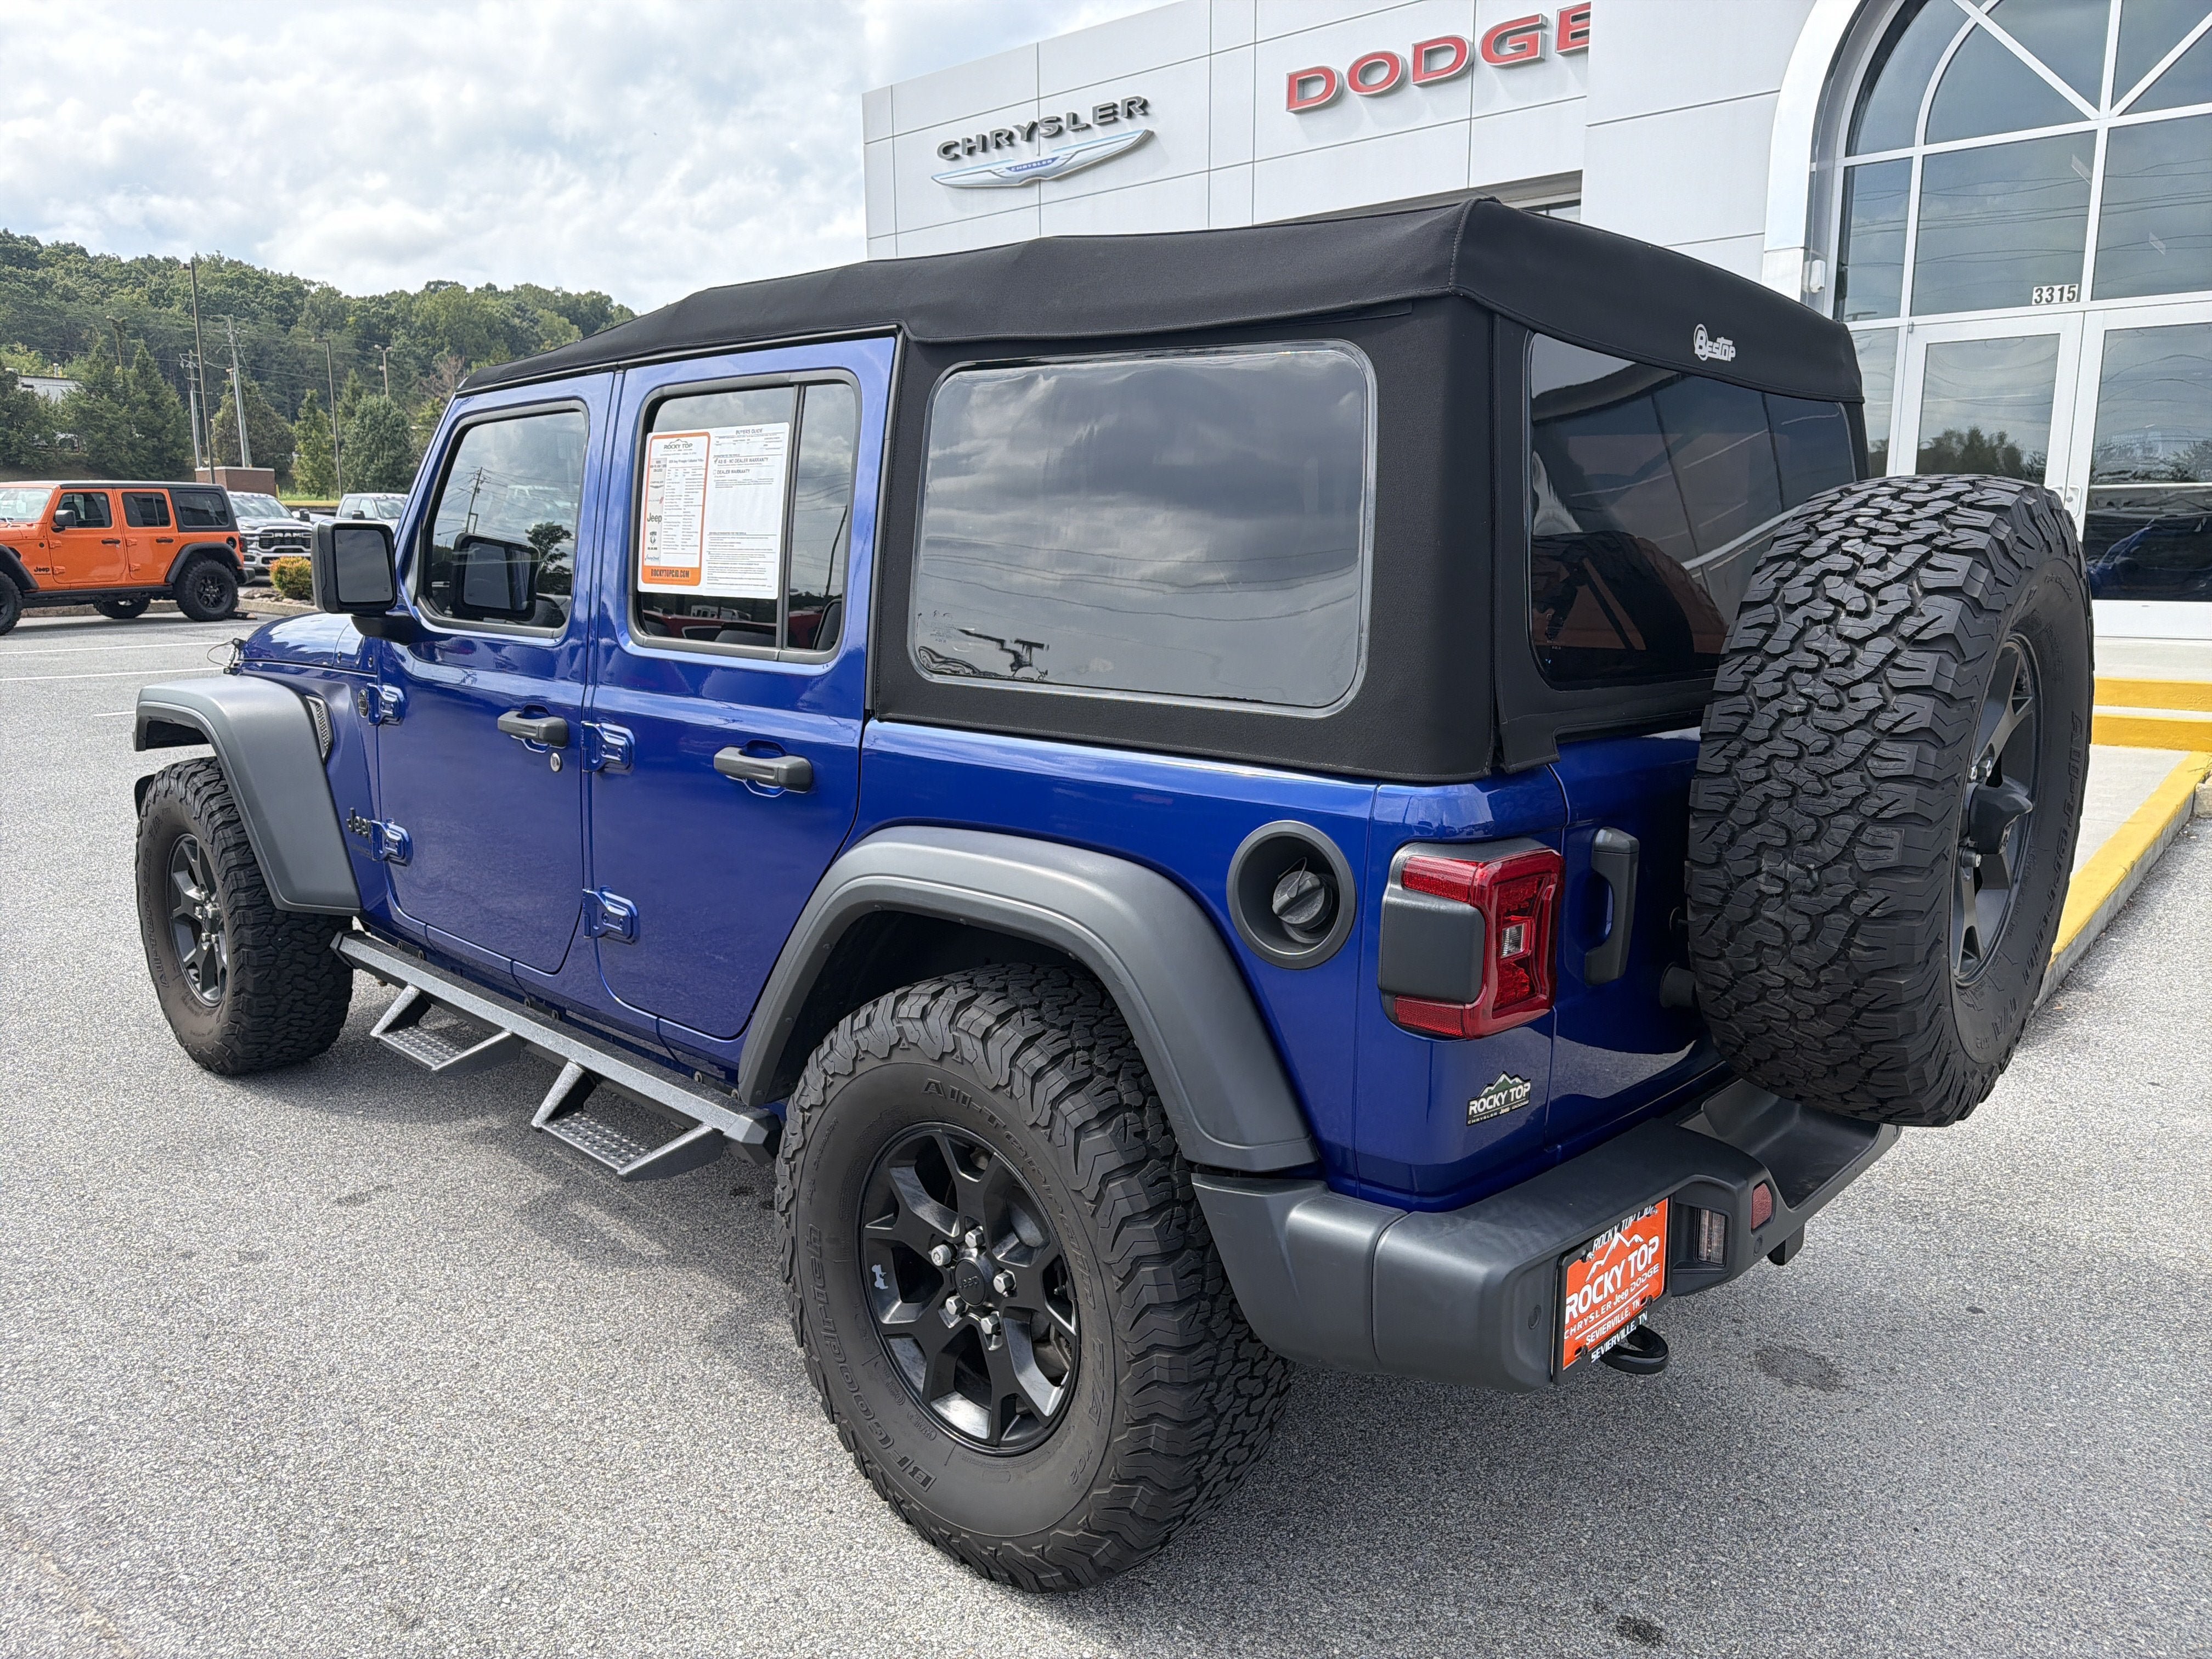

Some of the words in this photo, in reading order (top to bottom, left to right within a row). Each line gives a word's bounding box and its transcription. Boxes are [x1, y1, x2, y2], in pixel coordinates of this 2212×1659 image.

[1286, 1, 1591, 112] DODGE
[937, 95, 1148, 160] CHRYSLER
[1011, 159, 1053, 172] CHRYSLER
[2034, 285, 2076, 304] 3315
[647, 512, 663, 524] Jeep
[1468, 1112, 1498, 1124] CHRYSLER
[1469, 1089, 1509, 1116] ROCKY
[1509, 1082, 1531, 1102] TOP
[1592, 1222, 1620, 1253] ROCKY
[959, 1276, 979, 1289] Jeep
[1565, 1260, 1627, 1324] ROCKY
[1628, 1235, 1660, 1278] TOP
[1564, 1299, 1613, 1340] CHRYSLER
[1613, 1288, 1629, 1307] Jeep
[1630, 1262, 1660, 1294] DODGE
[1585, 1306, 1632, 1346] SEVIERVILLE,
[1632, 1297, 1641, 1312] TN
[1590, 1321, 1637, 1363] SEVIERVILLE,
[1638, 1310, 1648, 1325] TN
[807, 1223, 937, 1492] BFGoodrich
